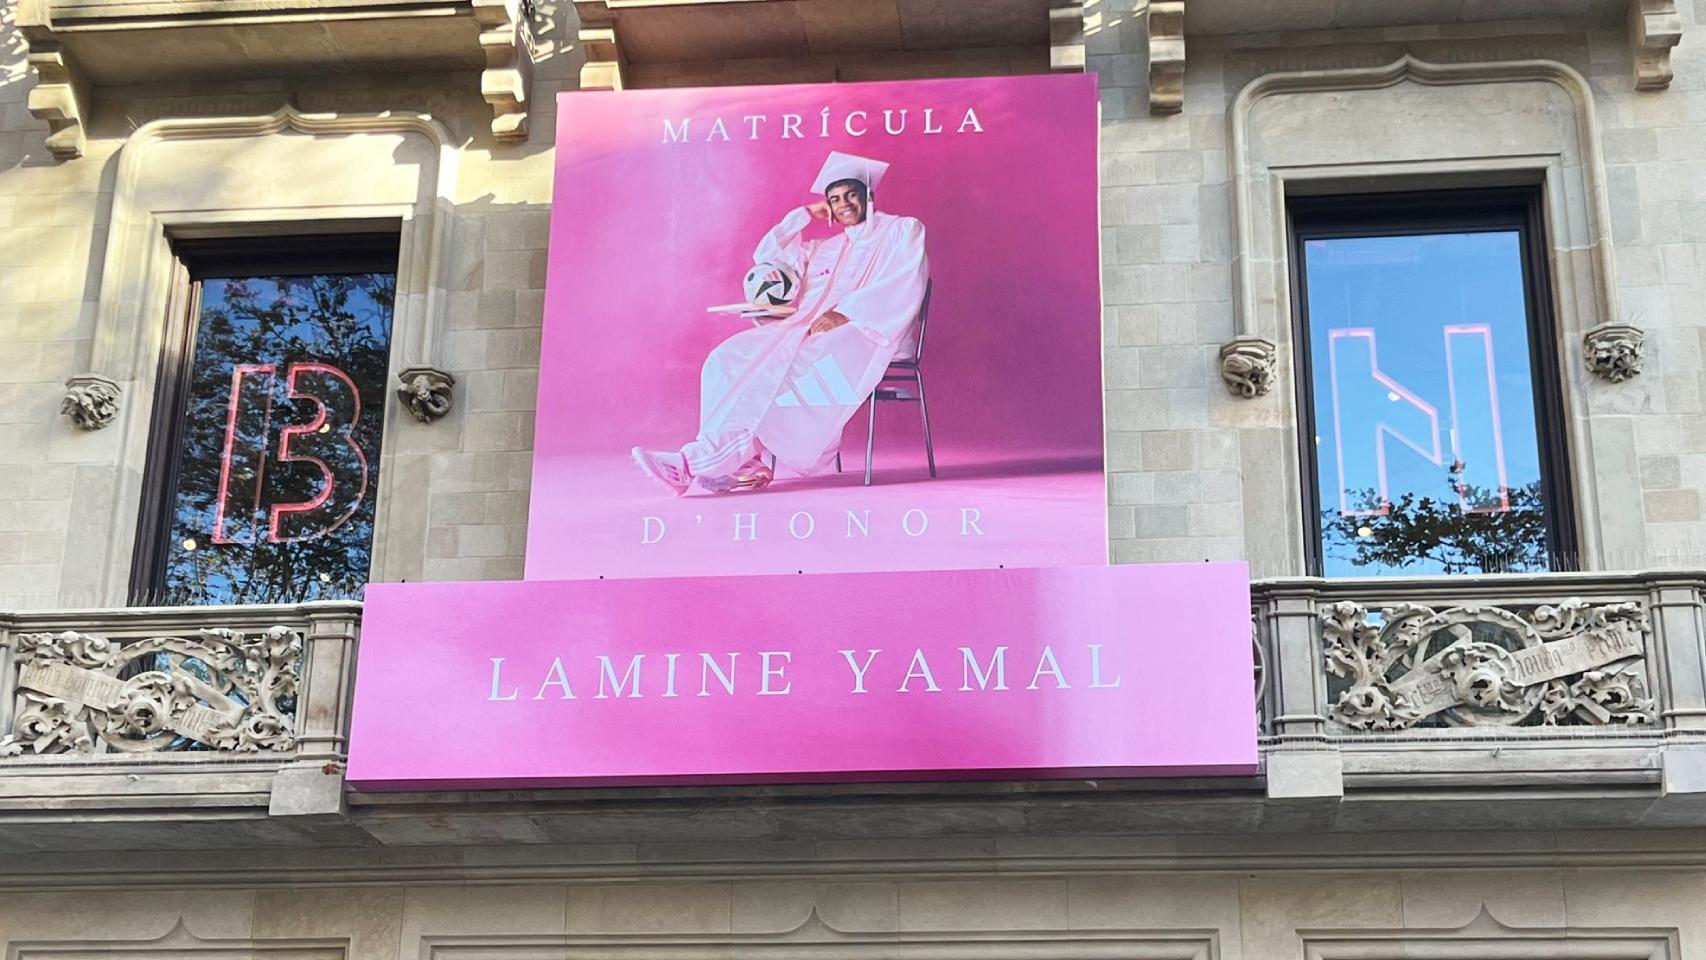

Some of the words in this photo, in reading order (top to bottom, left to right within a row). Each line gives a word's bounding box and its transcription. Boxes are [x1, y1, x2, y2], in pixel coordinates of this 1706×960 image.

[661, 106, 985, 144] MATRÍCULA
[211, 361, 368, 544] B
[1327, 323, 1510, 517] N
[486, 651, 793, 701] LAMINE
[838, 643, 1122, 694] YAMAL
